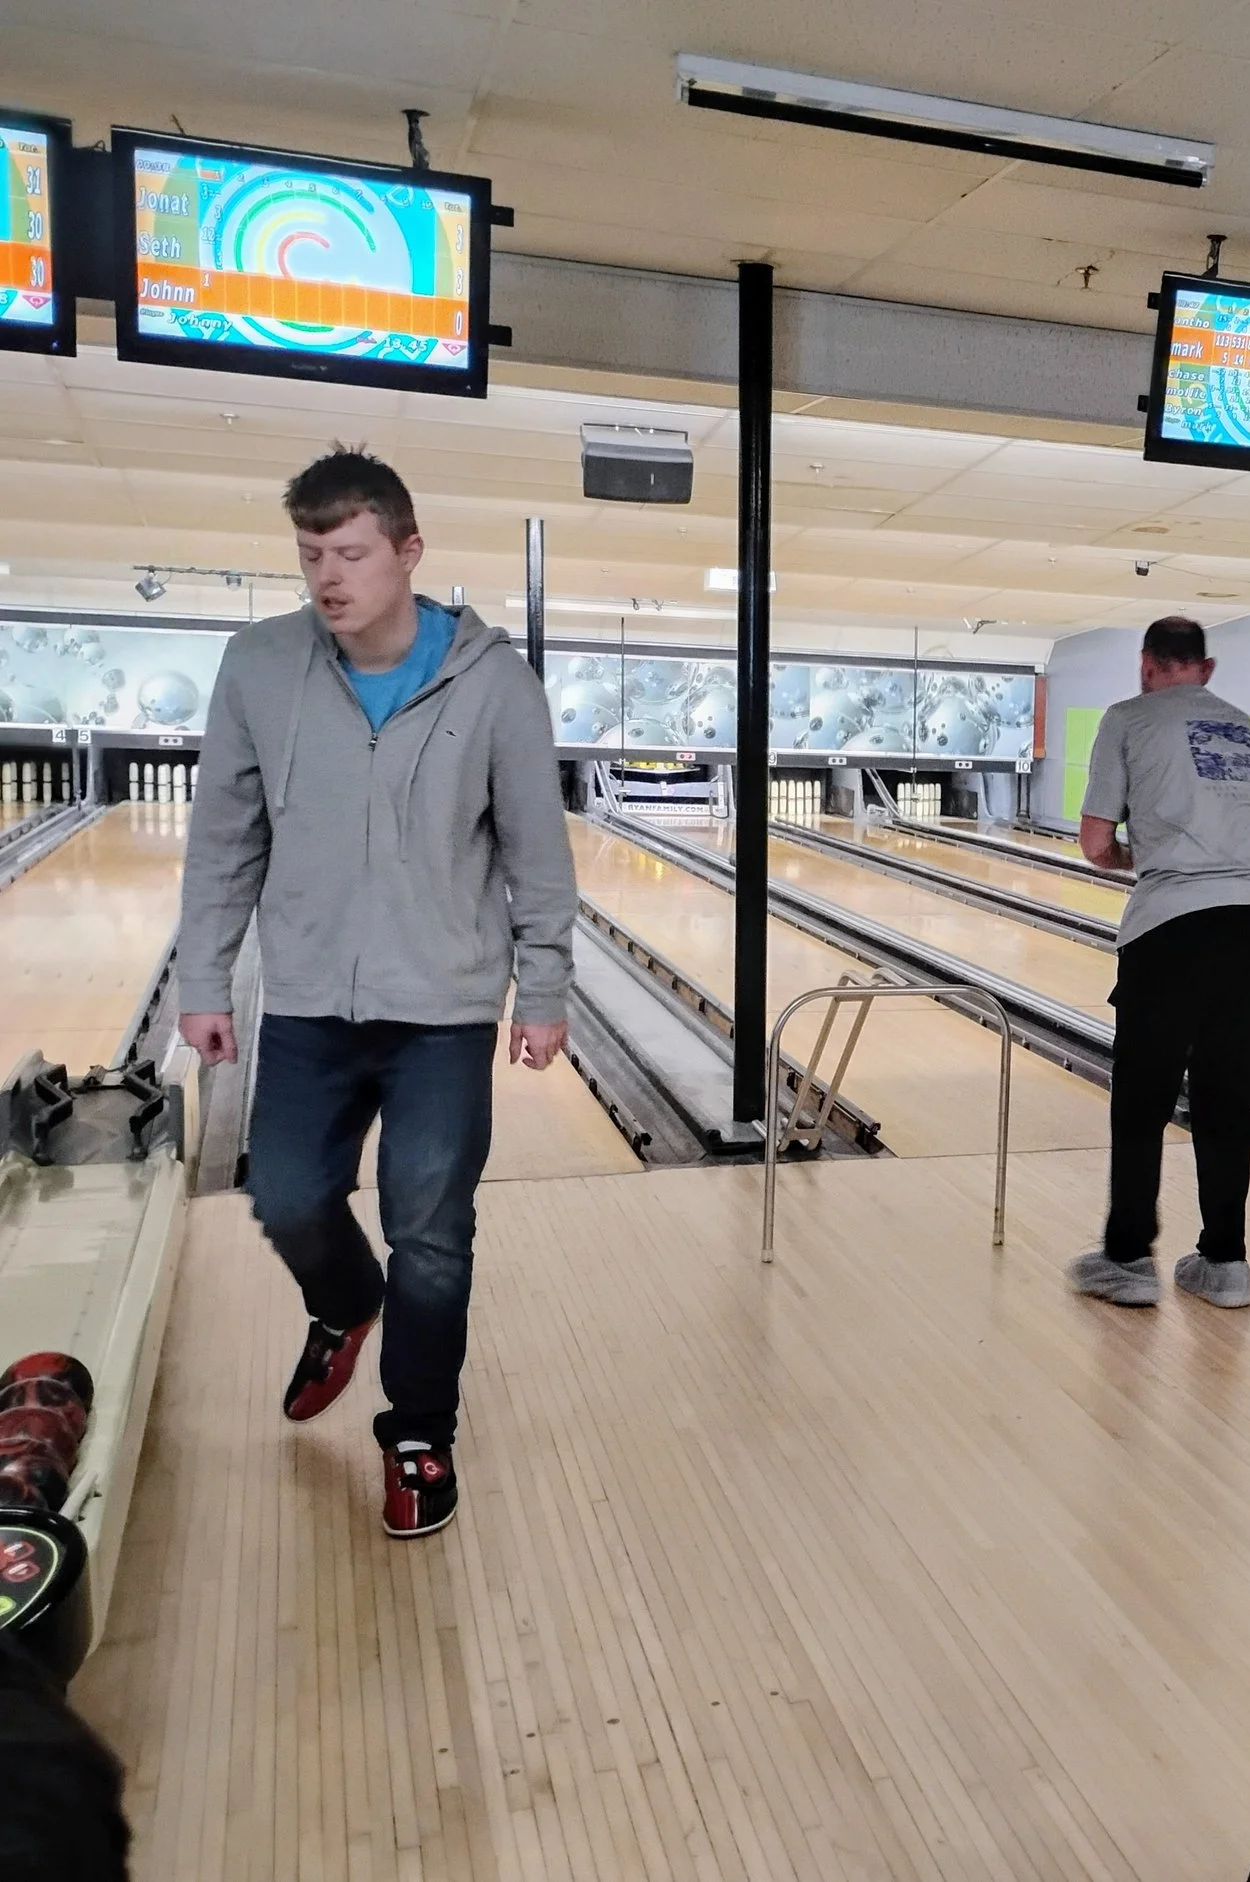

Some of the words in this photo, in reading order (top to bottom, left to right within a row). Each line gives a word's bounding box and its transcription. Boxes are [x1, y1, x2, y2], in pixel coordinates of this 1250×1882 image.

[26, 166, 42, 195] 31
[27, 211, 43, 241] 30
[138, 187, 189, 216] Jonat
[456, 224, 464, 253] 3
[139, 231, 181, 259] Seth
[456, 268, 464, 296] 3
[30, 256, 46, 288] 30
[140, 278, 195, 303] Johnn
[203, 273, 210, 287] 1
[455, 310, 463, 336] 0
[168, 312, 233, 331] Johnny
[1175, 314, 1209, 328] antho
[1171, 338, 1203, 358] mark
[1215, 335, 1229, 346] 113
[1231, 337, 1245, 348] 531
[1222, 352, 1228, 363] 5
[1233, 353, 1244, 365] 14
[1169, 368, 1204, 381] chase
[1165, 404, 1202, 417] Byron
[55, 729, 66, 741] 4
[79, 730, 90, 741] 5
[1018, 761, 1030, 772] 10
[628, 803, 704, 814] RYANFAMILY.COM
